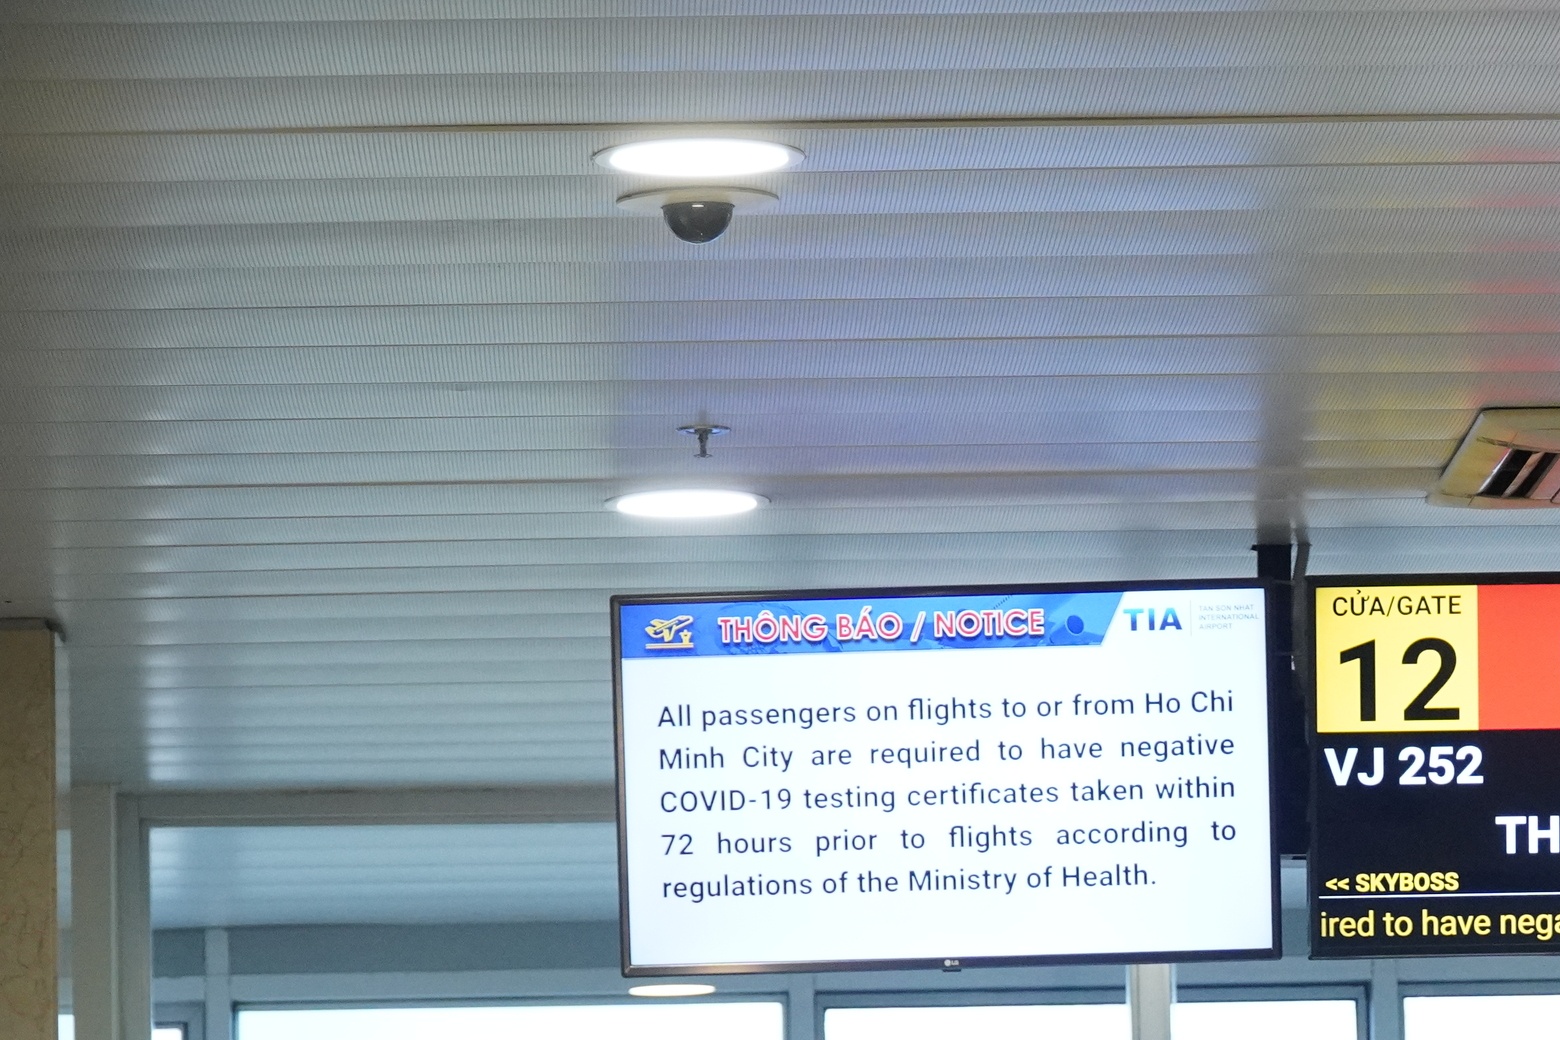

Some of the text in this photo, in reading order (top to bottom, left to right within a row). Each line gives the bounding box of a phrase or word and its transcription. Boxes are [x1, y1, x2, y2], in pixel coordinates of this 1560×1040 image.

[717, 611, 827, 643] THÔNG
[835, 605, 902, 642] BÁO
[933, 608, 1045, 638] NOTICE
[1122, 606, 1183, 631] TIA
[1198, 612, 1260, 621] INTERNATIONAL
[1199, 622, 1233, 630] AIRPORT
[1339, 637, 1460, 722] 12
[657, 689, 1233, 732] All passengers on flights to or from Ho Chi
[659, 733, 1235, 773] Minh City are required to have negative
[1323, 745, 1484, 787] VJ 252
[660, 775, 1235, 813] COVID-19 testing certificates taken within
[661, 820, 1236, 858] 72 hours prior to flights according to
[663, 863, 1156, 904] regulations of the Ministry of Health.
[1355, 871, 1460, 893] SKYBOSS
[1382, 912, 1414, 937] to
[1421, 908, 1492, 936] have
